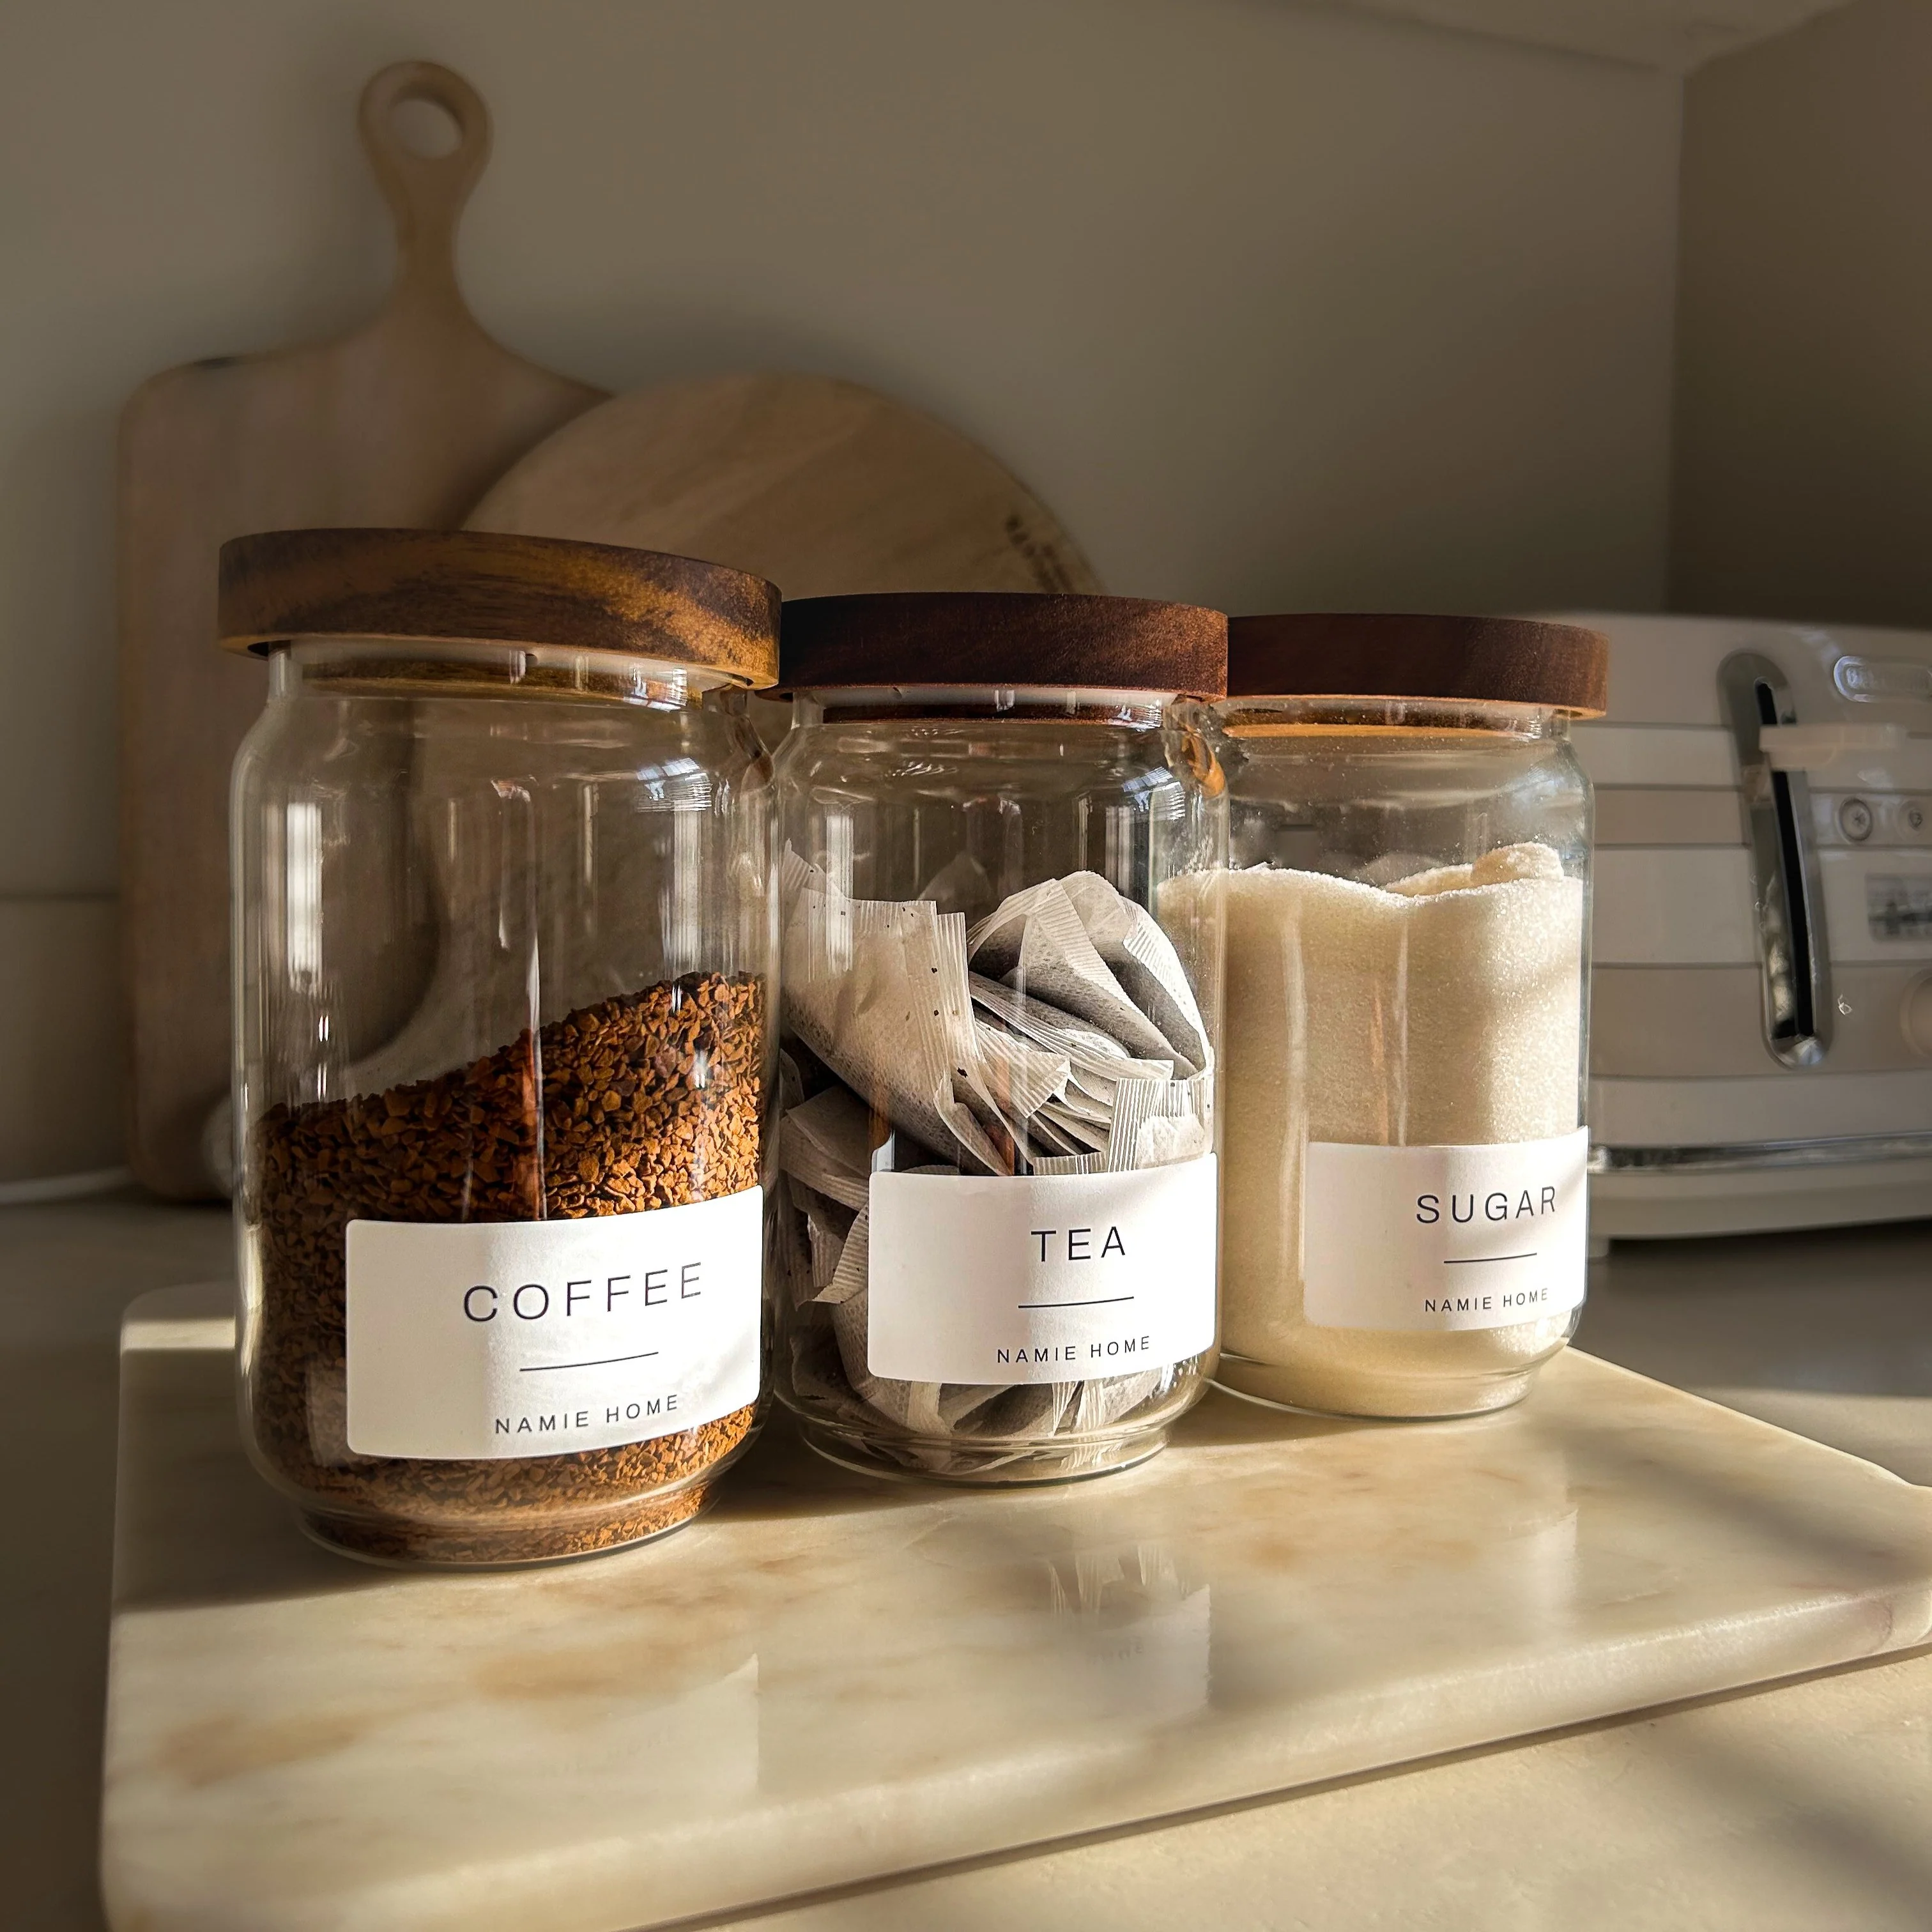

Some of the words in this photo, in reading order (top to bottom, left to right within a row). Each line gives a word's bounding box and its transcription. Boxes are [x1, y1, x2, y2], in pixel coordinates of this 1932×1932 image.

[1416, 1186, 1556, 1224] SUGAR
[1030, 1225, 1126, 1263] TEA
[463, 1262, 702, 1322] COFFEE
[1425, 1296, 1492, 1313] NAMIE
[1503, 1288, 1547, 1308] HOME
[997, 1346, 1076, 1364] NAMIE
[1091, 1335, 1150, 1358] HOME
[495, 1410, 589, 1434] NAMIE
[606, 1394, 678, 1423] HOME
